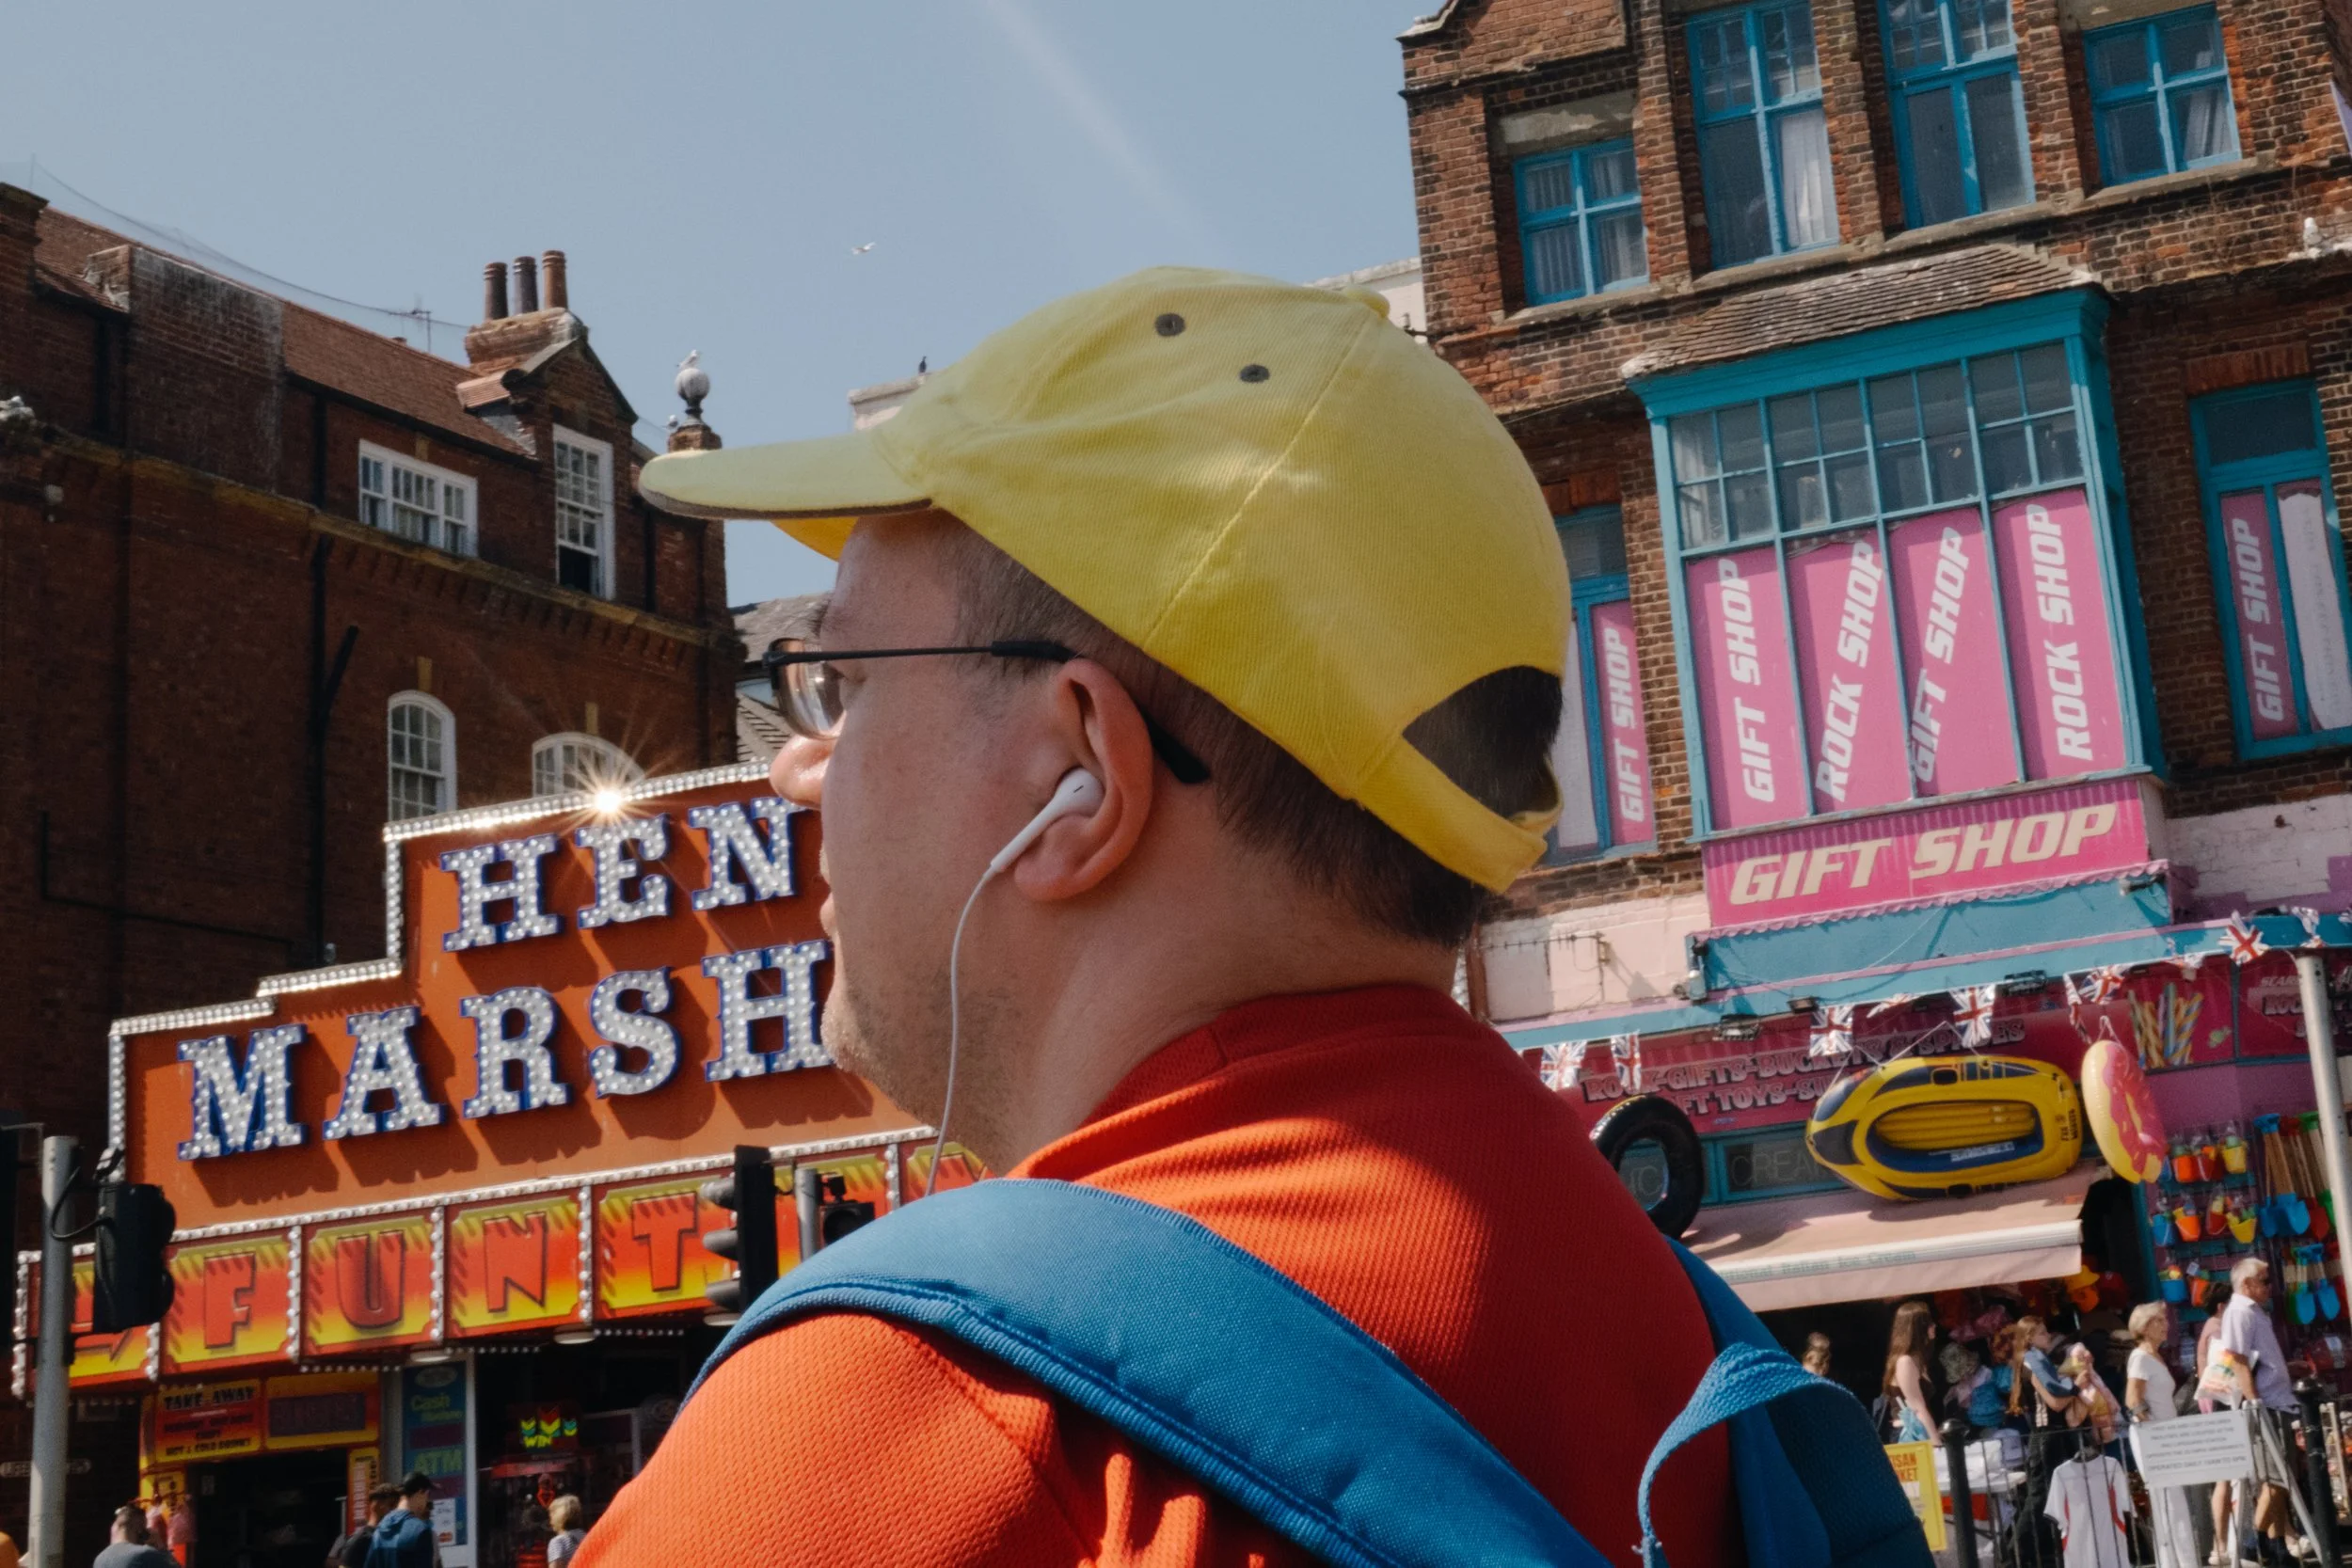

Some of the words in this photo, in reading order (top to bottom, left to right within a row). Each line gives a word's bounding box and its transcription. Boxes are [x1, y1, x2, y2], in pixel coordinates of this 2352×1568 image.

[1836, 542, 1883, 670] SHOP
[1924, 527, 1969, 665] SHOP
[2026, 504, 2074, 626] SHOP
[2232, 518, 2270, 625] SHOP
[1604, 627, 1637, 728] SHOP
[1718, 560, 1760, 688] SHOP
[2249, 635, 2283, 721] GIFT
[1734, 697, 1775, 803] GIFT
[1815, 673, 1866, 801] ROCK
[1908, 669, 1947, 784] GIFT
[2044, 640, 2092, 761] ROCK
[1613, 738, 1645, 823] GIFT
[1729, 837, 1891, 908] GIFT
[1910, 803, 2118, 881] SHOP
